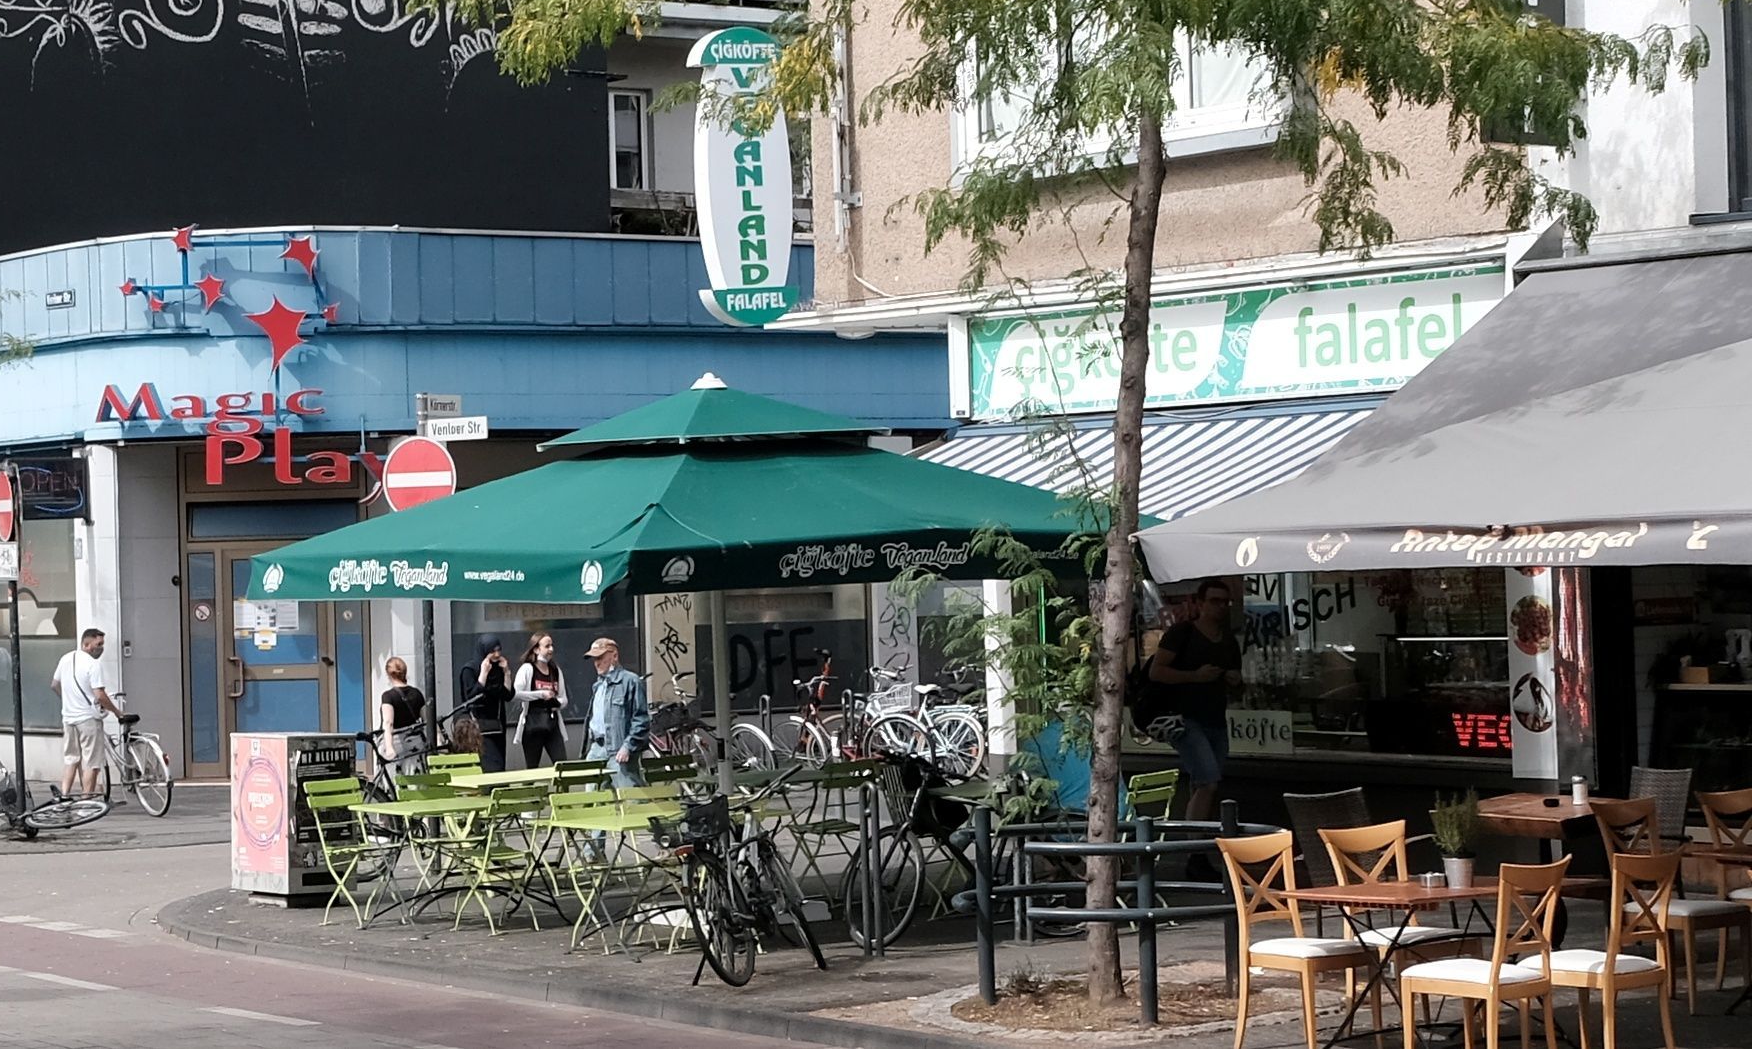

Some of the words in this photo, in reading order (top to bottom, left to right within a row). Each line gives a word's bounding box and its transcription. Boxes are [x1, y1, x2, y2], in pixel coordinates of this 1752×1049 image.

[726, 291, 787, 313] FALAFEL
[1015, 321, 1199, 399] çiğköte
[1293, 293, 1463, 369] falafel
[95, 382, 327, 437] Magic
[431, 422, 465, 436] Venloer
[467, 420, 484, 435] Str.
[20, 471, 78, 493] OPEN
[205, 426, 383, 507] Play
[1502, 521, 1648, 560] Mangal
[778, 544, 876, 579] çiğköfte
[1474, 551, 1576, 563] RESTAURANT
[1229, 717, 1292, 747] köfte
